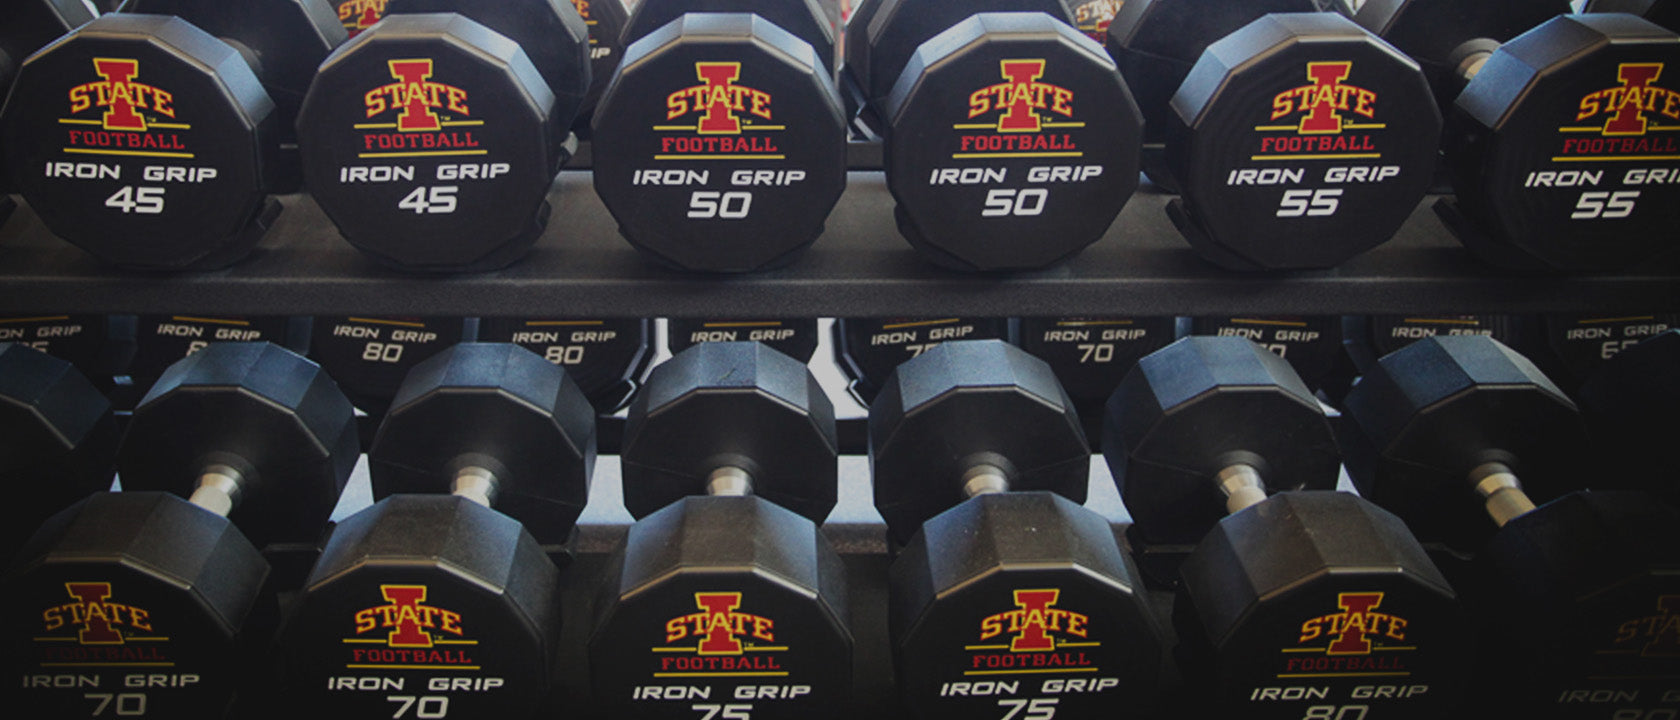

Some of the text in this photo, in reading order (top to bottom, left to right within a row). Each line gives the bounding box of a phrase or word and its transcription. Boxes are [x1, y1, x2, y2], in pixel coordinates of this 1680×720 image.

[69, 80, 176, 118] STATE
[365, 82, 469, 118] STATE
[667, 84, 772, 120] STATE
[968, 81, 1073, 119] STATE
[1270, 84, 1377, 121] STATE
[1576, 86, 1680, 122] STATE
[69, 130, 185, 150] FOOTBALL
[364, 131, 479, 150] FOOTBALL
[661, 136, 778, 153] FOOTBALL
[961, 134, 1076, 151] FOOTBALL
[1260, 135, 1375, 153] FOOTBALL
[1562, 137, 1678, 154] FOOTBALL
[45, 161, 217, 183] IRON GRIP
[340, 162, 510, 183] IRON GRIP
[632, 169, 806, 186] IRON GRIP
[929, 165, 1103, 185] IRON GRIP
[1227, 165, 1400, 186] IRON GRIP
[1524, 168, 1680, 188] IRON GRI
[105, 185, 166, 214] 45
[398, 185, 459, 214] 45
[687, 191, 753, 219] 50
[981, 188, 1049, 217] 50
[1276, 188, 1344, 217] 55
[1571, 190, 1641, 219] 55
[36, 325, 82, 338] GRIP
[157, 324, 261, 341] IRON GRIP
[333, 325, 437, 343] IRON GRIP
[512, 331, 617, 344] IRON GRIP
[690, 329, 795, 344] IRON GRIP
[870, 325, 974, 346] IRON GRIP
[1044, 329, 1146, 342] IRON GRIP
[1217, 326, 1320, 342] IRON GRIP
[1391, 327, 1438, 339] IRON
[1567, 323, 1668, 340] IRON GRIP
[362, 342, 404, 363] 80
[544, 344, 585, 365] 80
[1077, 343, 1114, 363] 70
[42, 601, 153, 632] STATE
[355, 605, 463, 636] STATE
[980, 609, 1088, 641] STATE
[666, 612, 774, 643] STATE
[1298, 612, 1408, 643] STATE
[1613, 615, 1680, 643] STA
[44, 646, 166, 662] FOOTBALL
[353, 648, 472, 664] FOOTBALL
[662, 656, 781, 670] FOOTBALL
[973, 652, 1091, 668] FOOTBALL
[1286, 655, 1406, 672] FOOTBALL
[23, 674, 200, 688] IRON GRIP
[328, 676, 504, 691] IRON GRIP
[940, 678, 1119, 697] IRON GRIP
[632, 685, 811, 700] IRON GRIP
[1250, 685, 1429, 701] IRON GRIP
[1558, 689, 1639, 703] IRON
[84, 693, 147, 716] 70
[386, 695, 449, 719] 70
[691, 704, 753, 720] 75
[997, 698, 1060, 720] 75
[1302, 704, 1369, 720] 80
